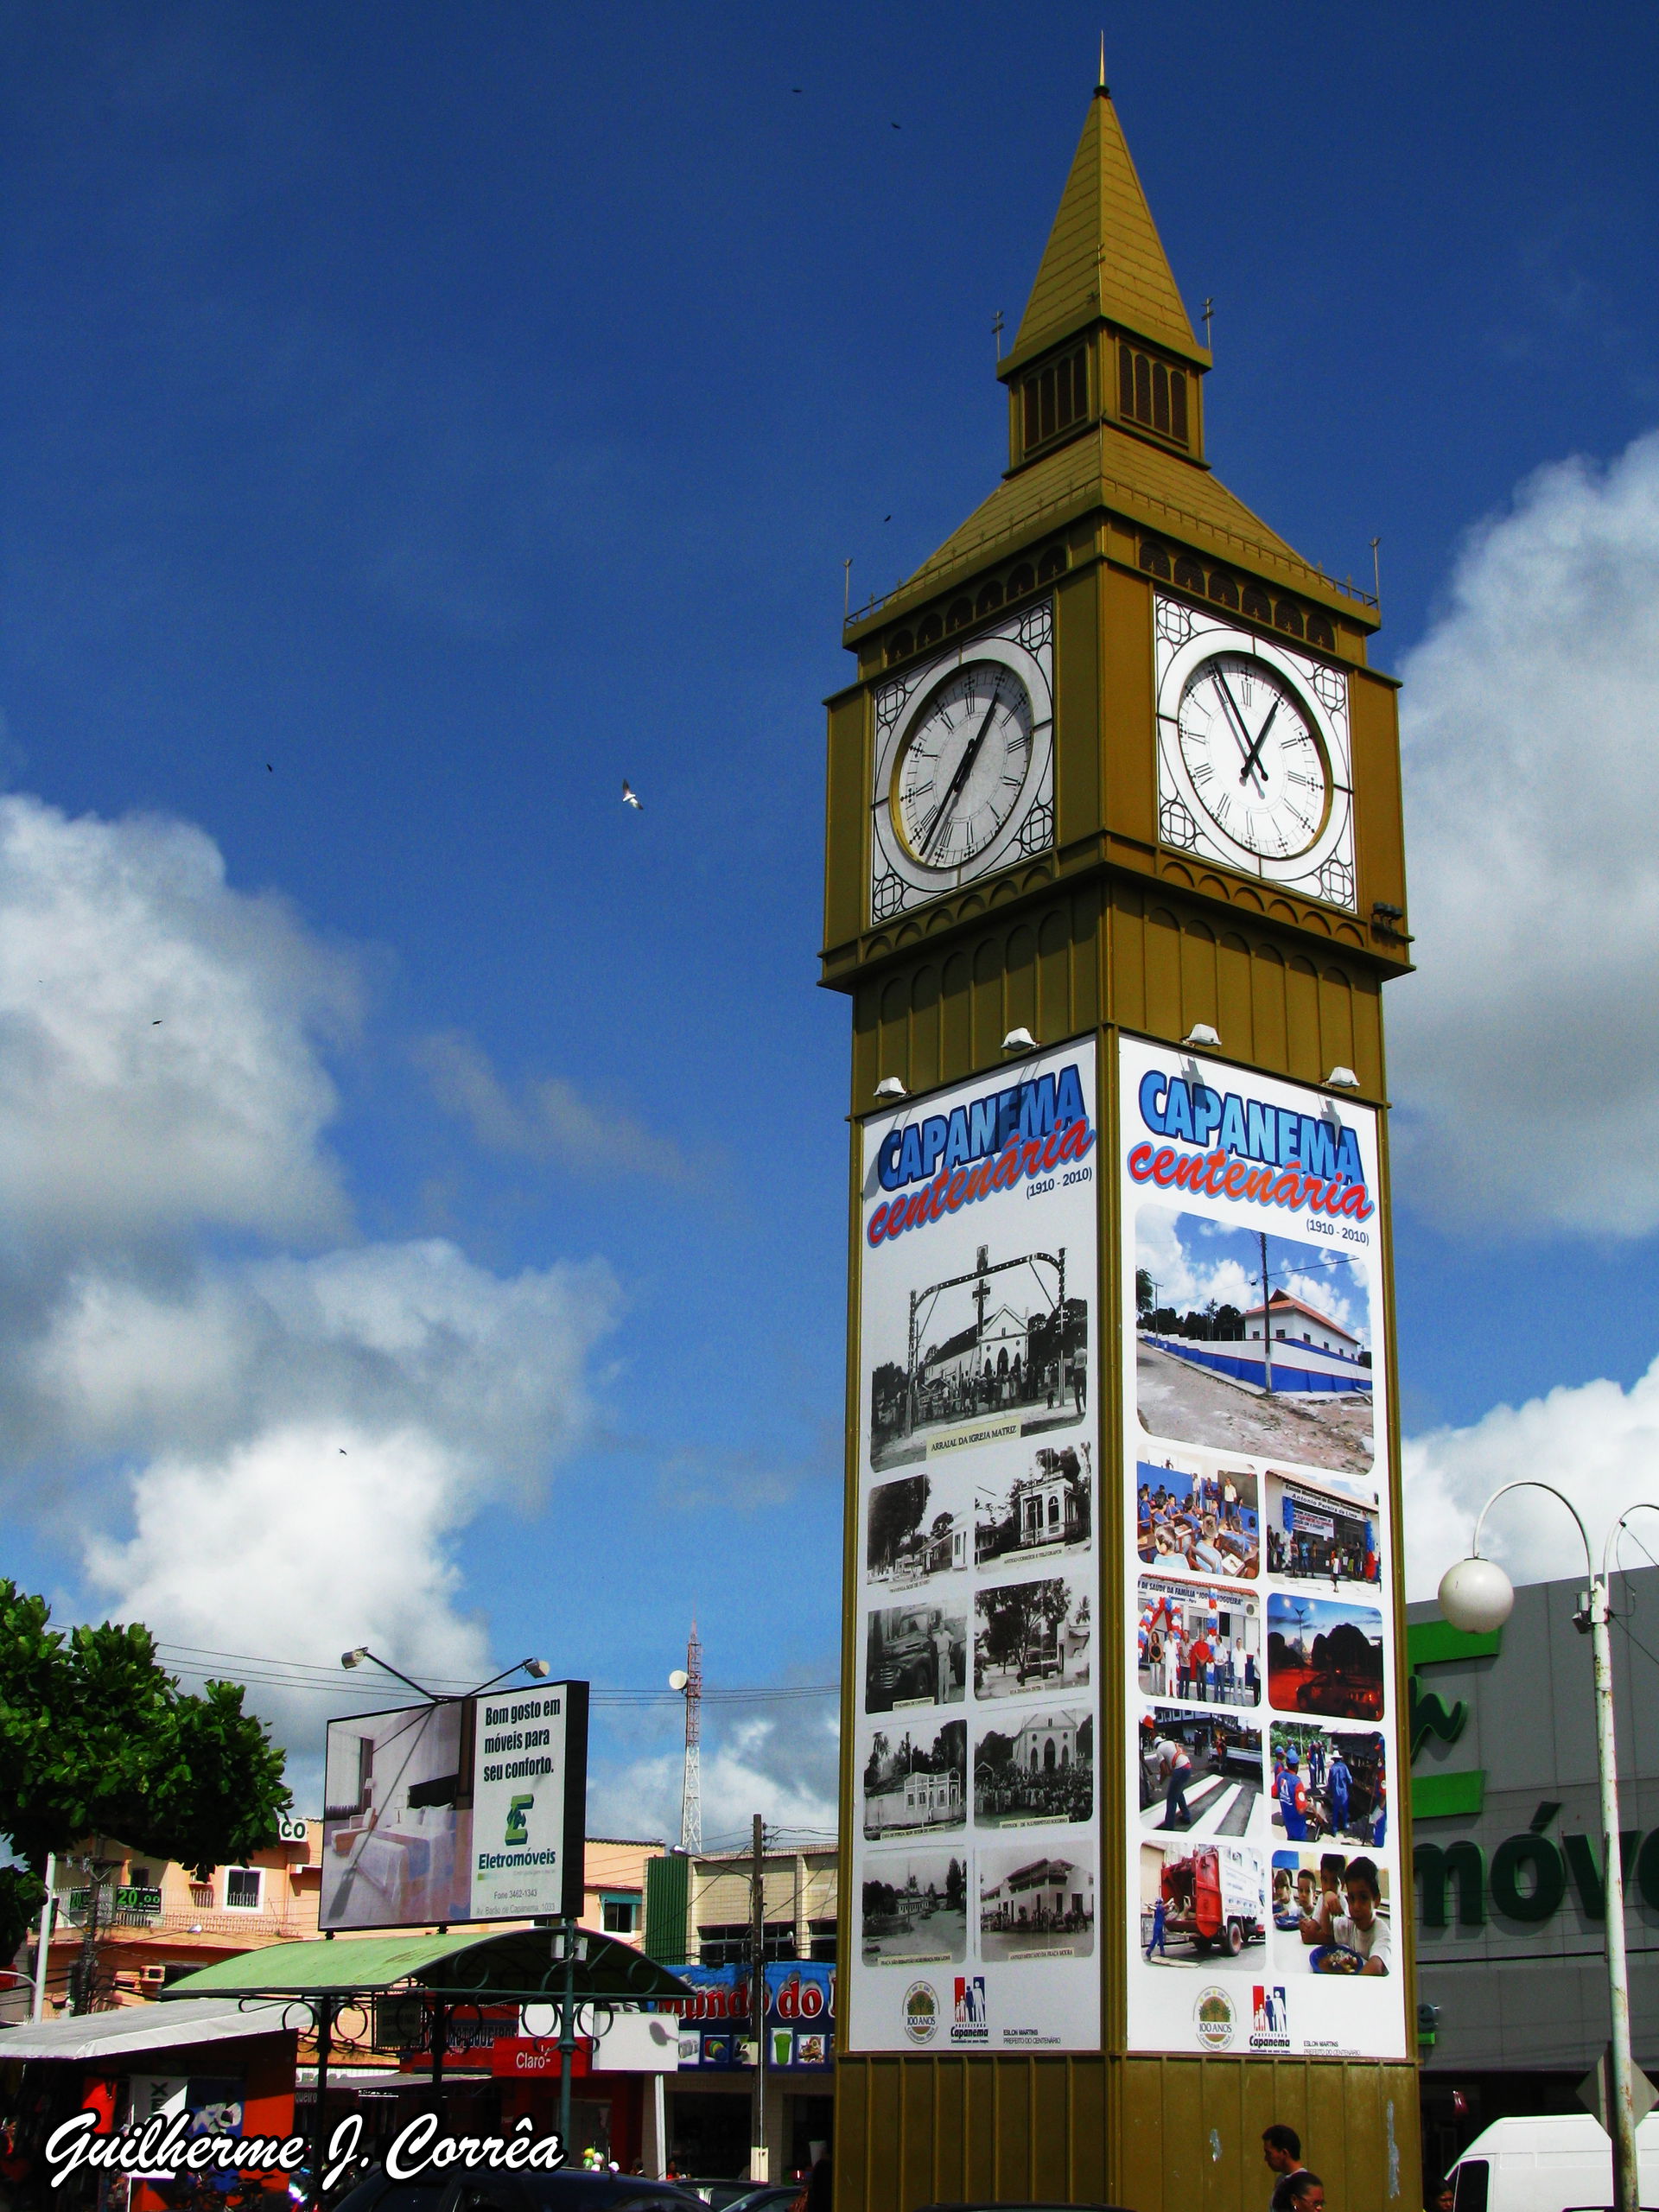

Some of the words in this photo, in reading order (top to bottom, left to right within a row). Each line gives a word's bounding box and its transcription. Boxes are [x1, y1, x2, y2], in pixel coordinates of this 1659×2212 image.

[878, 1064, 1086, 1192] CAPANEMA
[1139, 1070, 1365, 1186] CAPANEMA
[868, 1115, 1096, 1248] centenária
[1027, 1175, 1054, 1199] (1910
[1063, 1166, 1093, 1189] 2010)
[1128, 1141, 1375, 1223] centenária
[1306, 1218, 1334, 1236] (1910
[1342, 1230, 1370, 1246] 2010)
[931, 1438, 957, 1452] ARRAIAL
[958, 1437, 968, 1446] DA
[969, 1432, 990, 1443] IGREJA
[992, 1425, 1017, 1438] MATRIZ
[486, 1707, 508, 1726] Bom
[512, 1701, 541, 1724] gosto
[543, 1698, 560, 1717] em
[485, 1731, 523, 1754] móveis
[525, 1729, 550, 1750] para
[484, 1764, 503, 1782] seu
[505, 1757, 554, 1779] conforto.
[479, 1847, 556, 1870] Eletromóveis
[1413, 1802, 1659, 1927] móv
[494, 1891, 507, 1899] Fone
[777, 1978, 823, 2018] do
[918, 2016, 935, 2025] ANOS
[951, 2026, 988, 2039] Capanema
[1212, 2024, 1231, 2033] ANOS
[1249, 2036, 1290, 2048] Capanema
[516, 2051, 545, 2069] Claro
